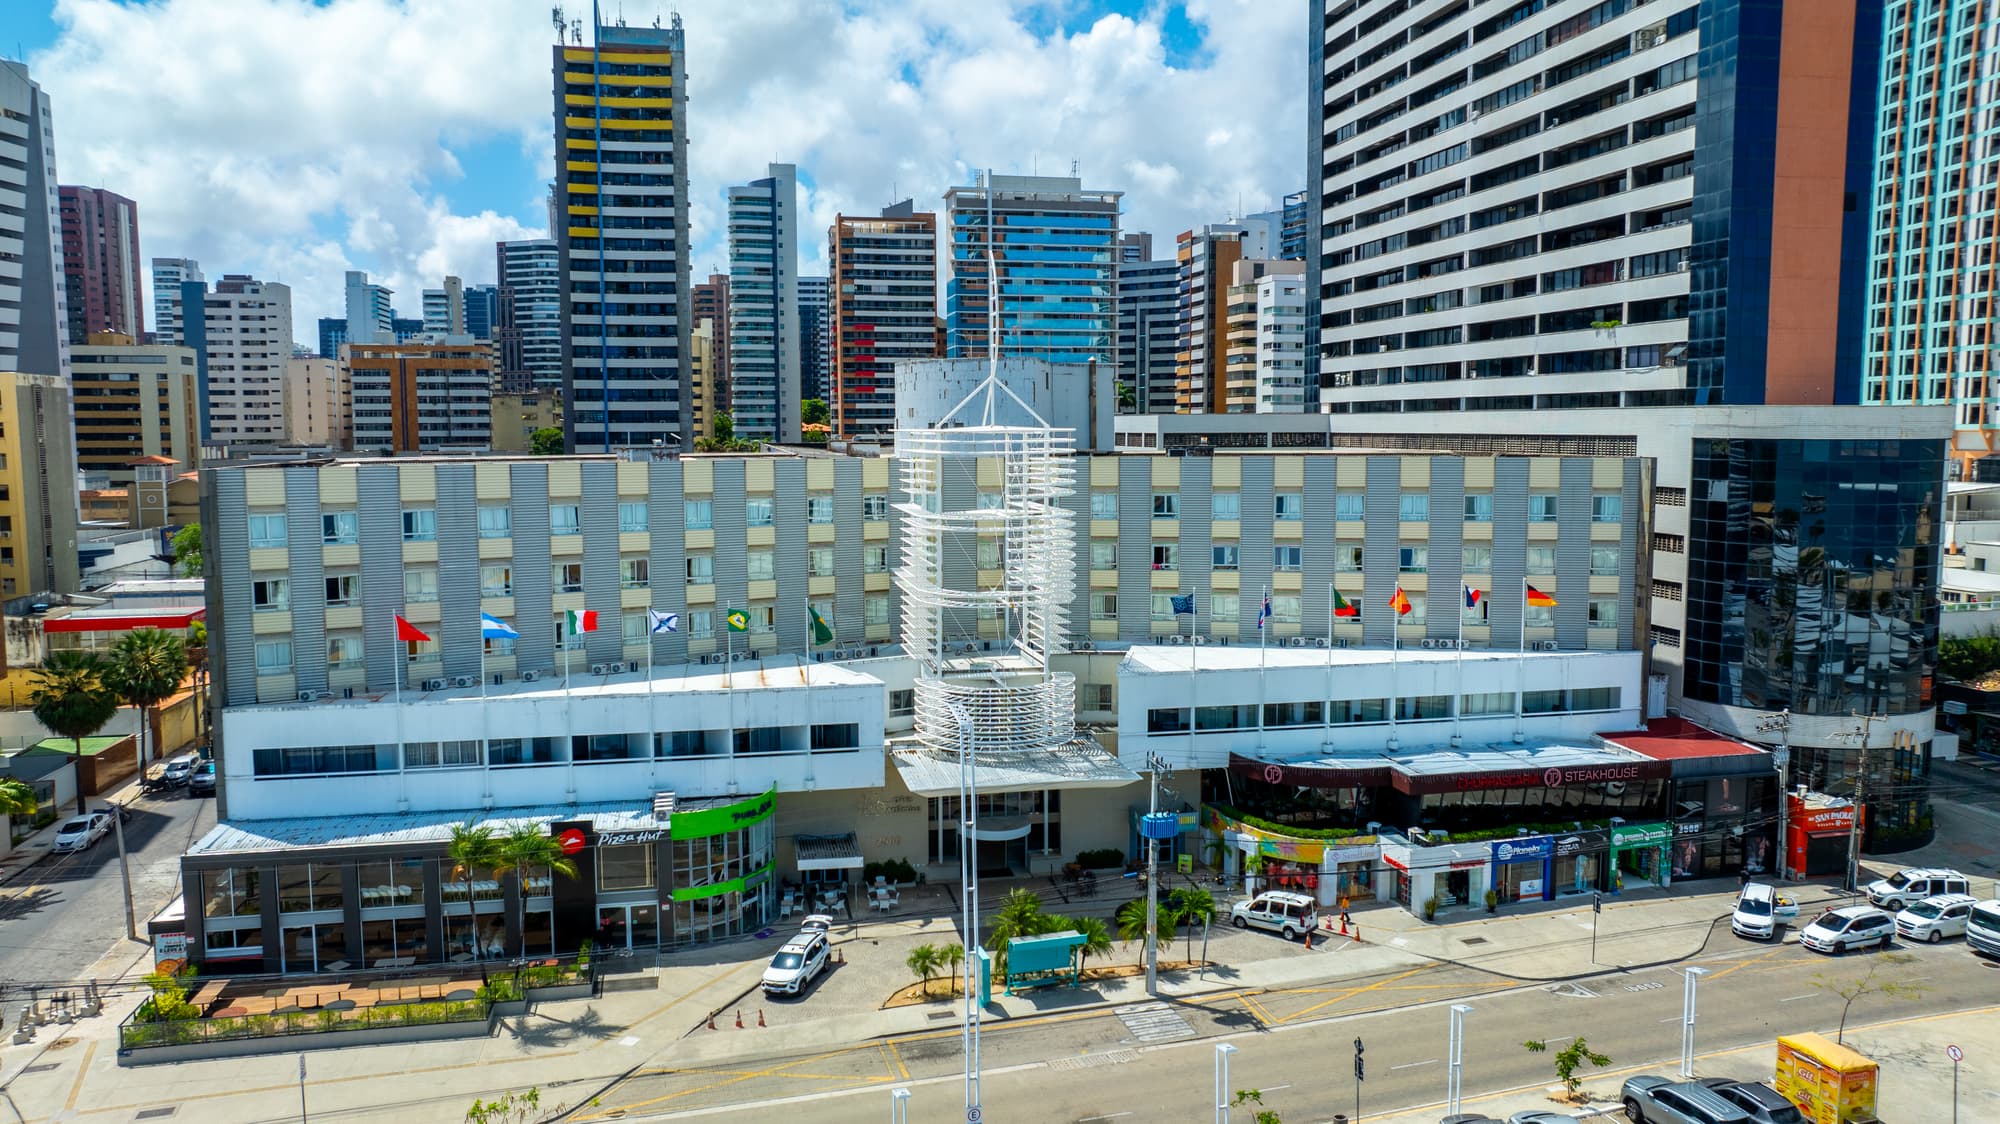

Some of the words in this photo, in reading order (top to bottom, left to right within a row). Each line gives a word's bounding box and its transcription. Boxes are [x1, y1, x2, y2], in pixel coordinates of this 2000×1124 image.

[1565, 767, 1639, 783] STEAKHOUSE
[1815, 813, 1830, 823] SAN
[597, 833, 635, 848] Pizza
[637, 830, 665, 844] Hut
